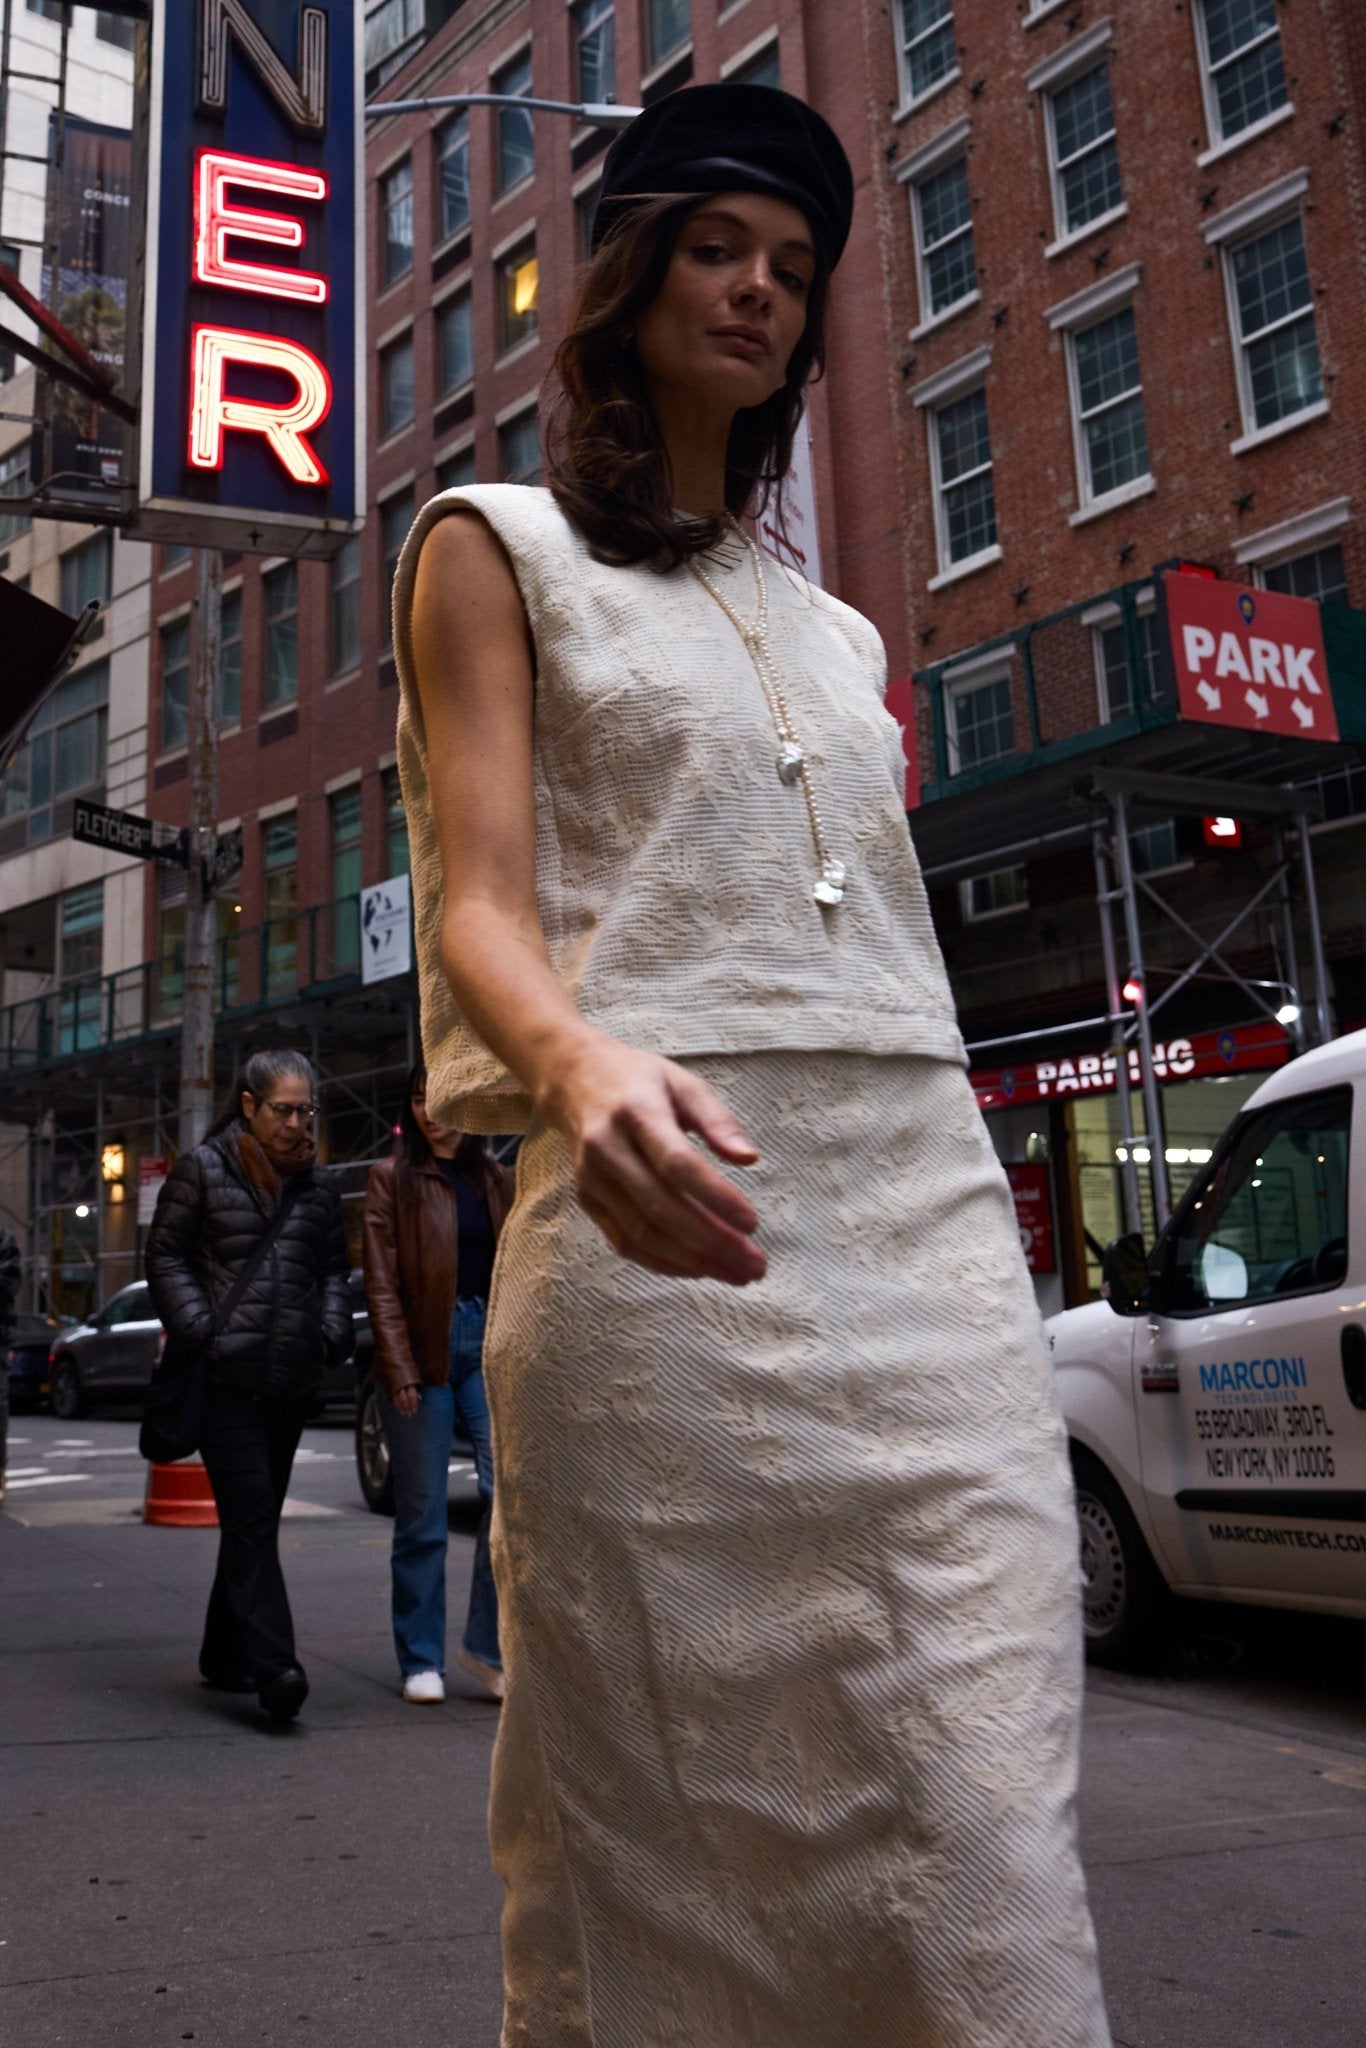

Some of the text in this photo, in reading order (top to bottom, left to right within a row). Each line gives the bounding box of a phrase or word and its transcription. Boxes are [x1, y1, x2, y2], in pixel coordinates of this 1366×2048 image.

[1182, 624, 1322, 695] PARK
[75, 808, 142, 850] FLETCHER
[1199, 1357, 1308, 1392] MARCONI
[1216, 1391, 1298, 1405] TECHNOLOGIES
[1195, 1409, 1212, 1439] 55
[1284, 1405, 1313, 1438] 3RD
[1313, 1405, 1334, 1437] FL
[1207, 1447, 1233, 1478] NEW
[1273, 1447, 1291, 1478] NY
[1292, 1446, 1335, 1478] 10006
